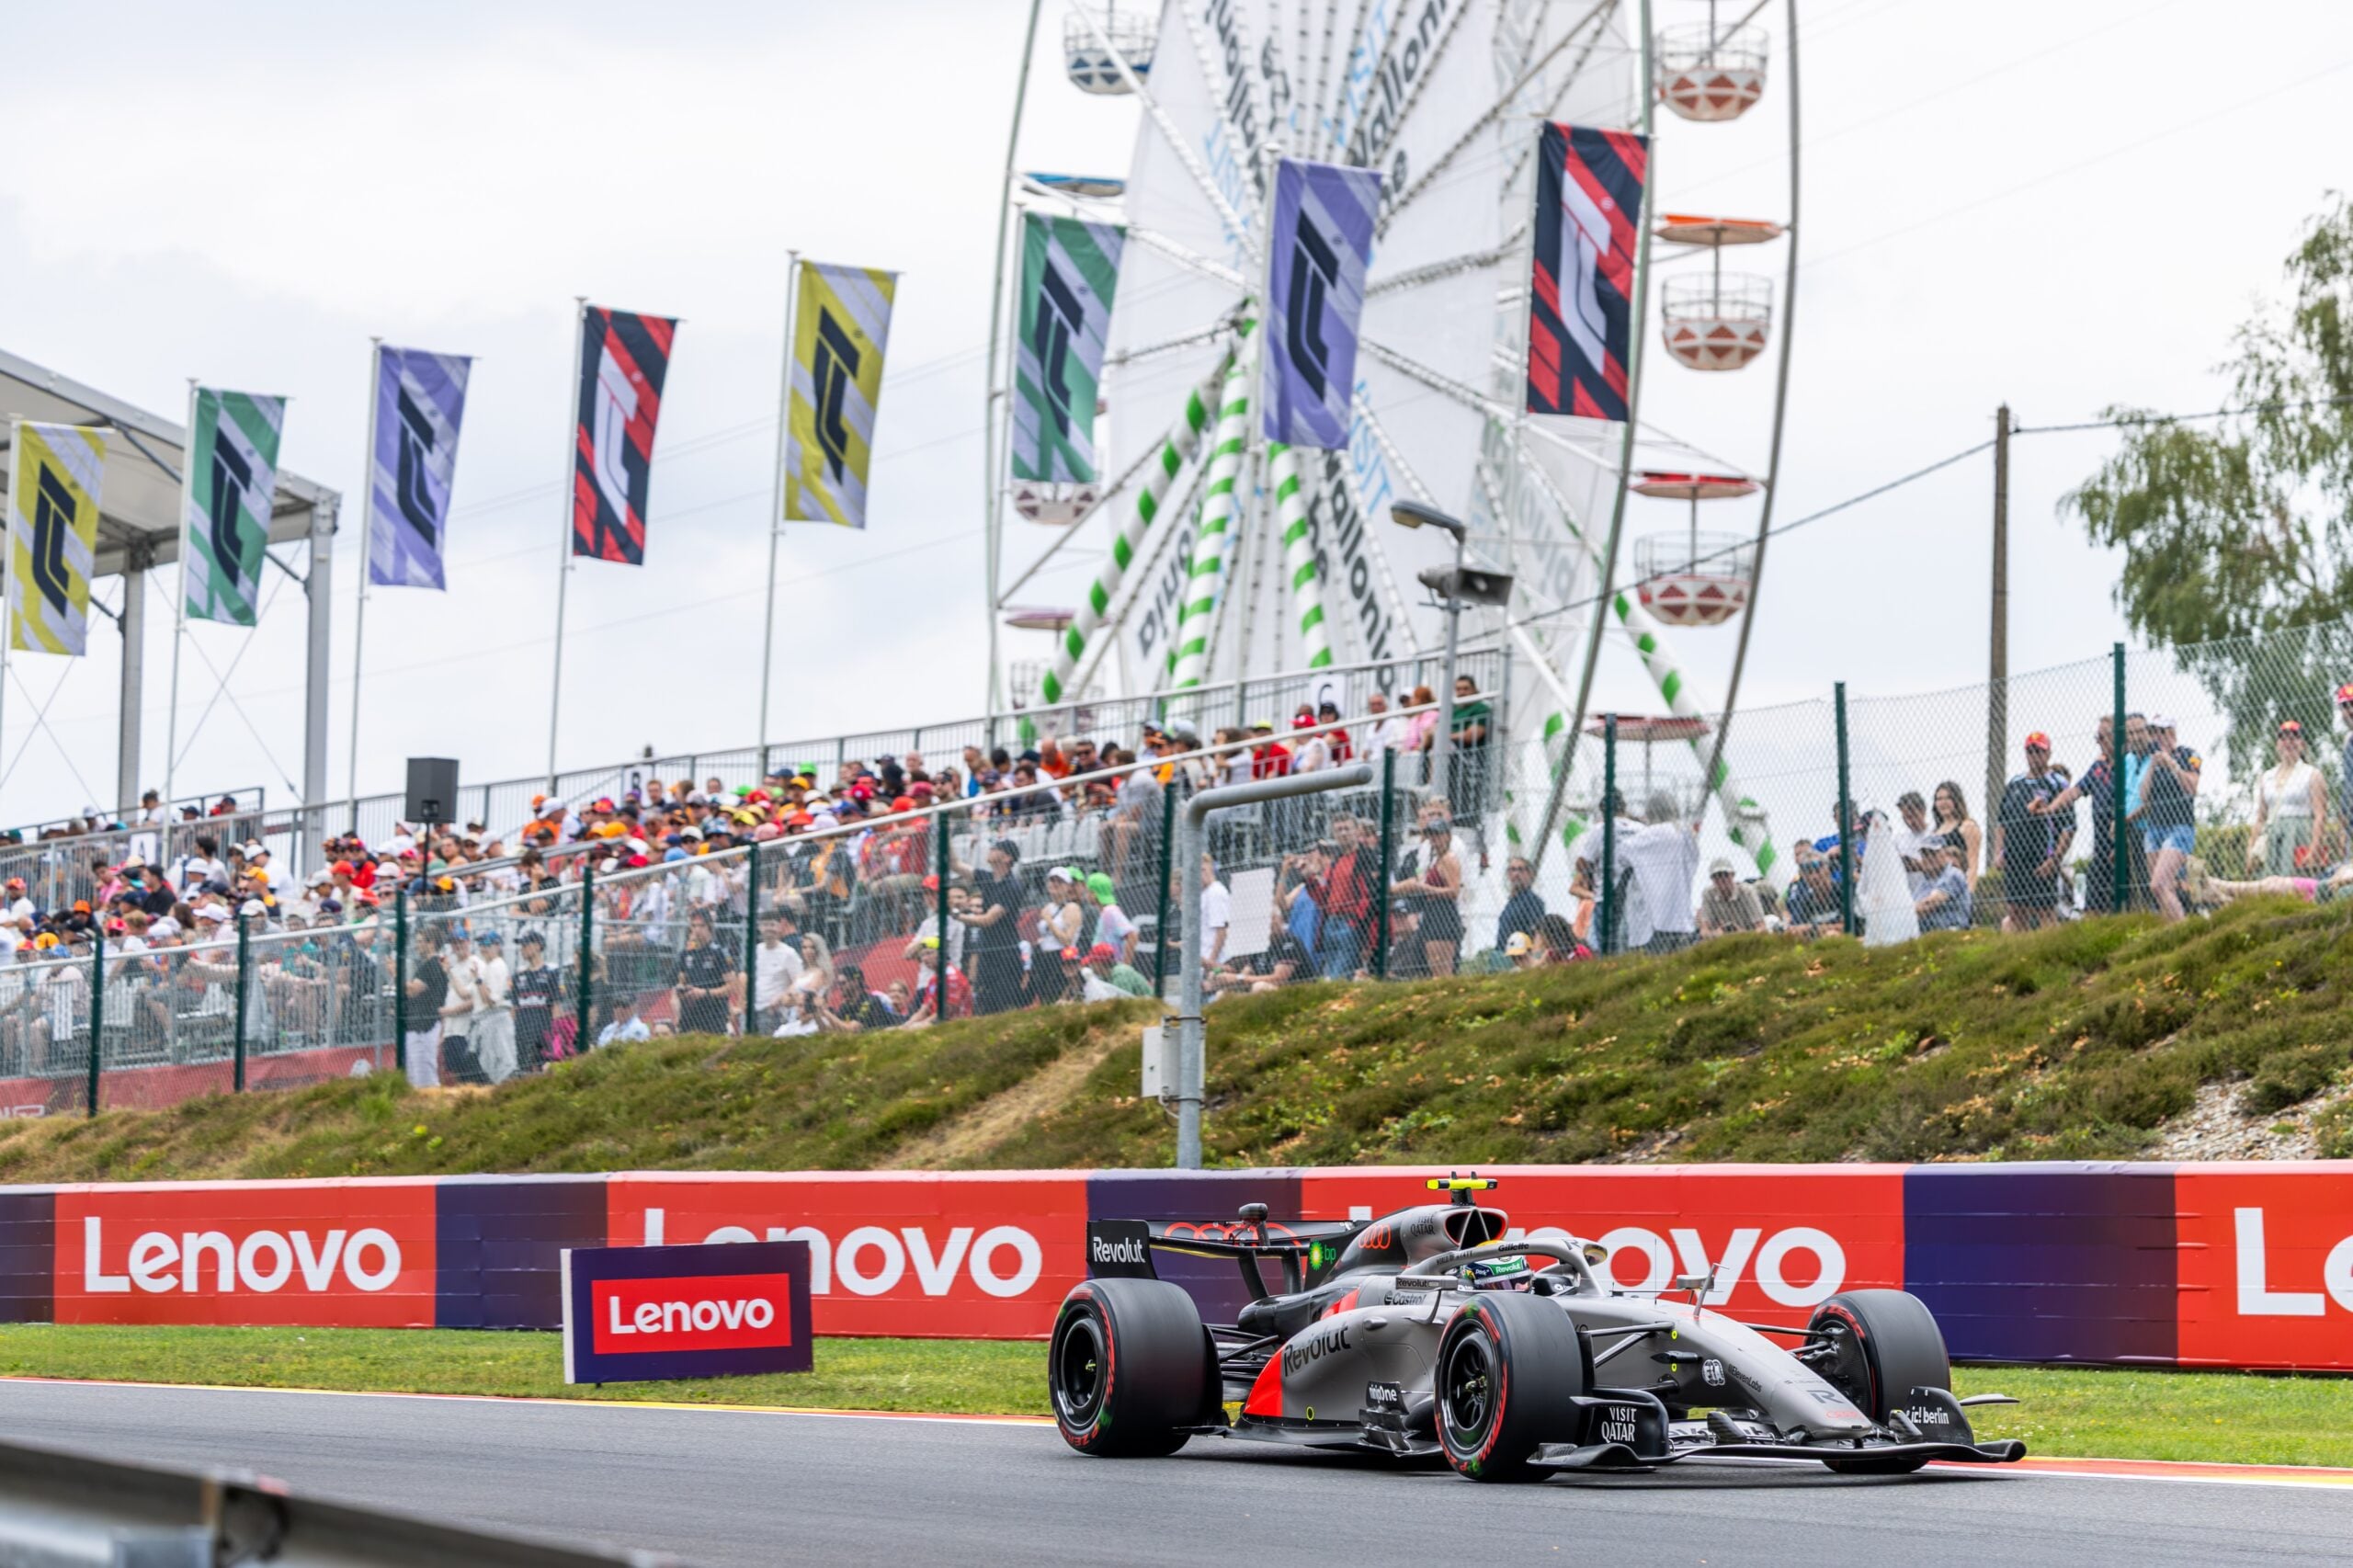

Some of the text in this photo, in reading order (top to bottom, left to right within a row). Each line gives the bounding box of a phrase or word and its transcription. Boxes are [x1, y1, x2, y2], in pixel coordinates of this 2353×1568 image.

[1410, 1223, 1436, 1237] QATAR
[85, 1216, 402, 1293] Lenovo
[645, 1208, 1042, 1298] novo
[1093, 1236, 1146, 1263] Revolut
[1324, 1246, 1336, 1265] bp
[1498, 1243, 1529, 1252] Gillette
[1495, 1262, 1521, 1274] Revolut
[1397, 1278, 1427, 1288] Revolut
[1392, 1293, 1427, 1305] Castrol
[609, 1295, 774, 1335] Lenovo
[1283, 1322, 1352, 1377] Revolut
[1609, 1407, 1637, 1422] VISIT
[1923, 1406, 1949, 1424] berlin
[1601, 1422, 1635, 1443] QATAR
